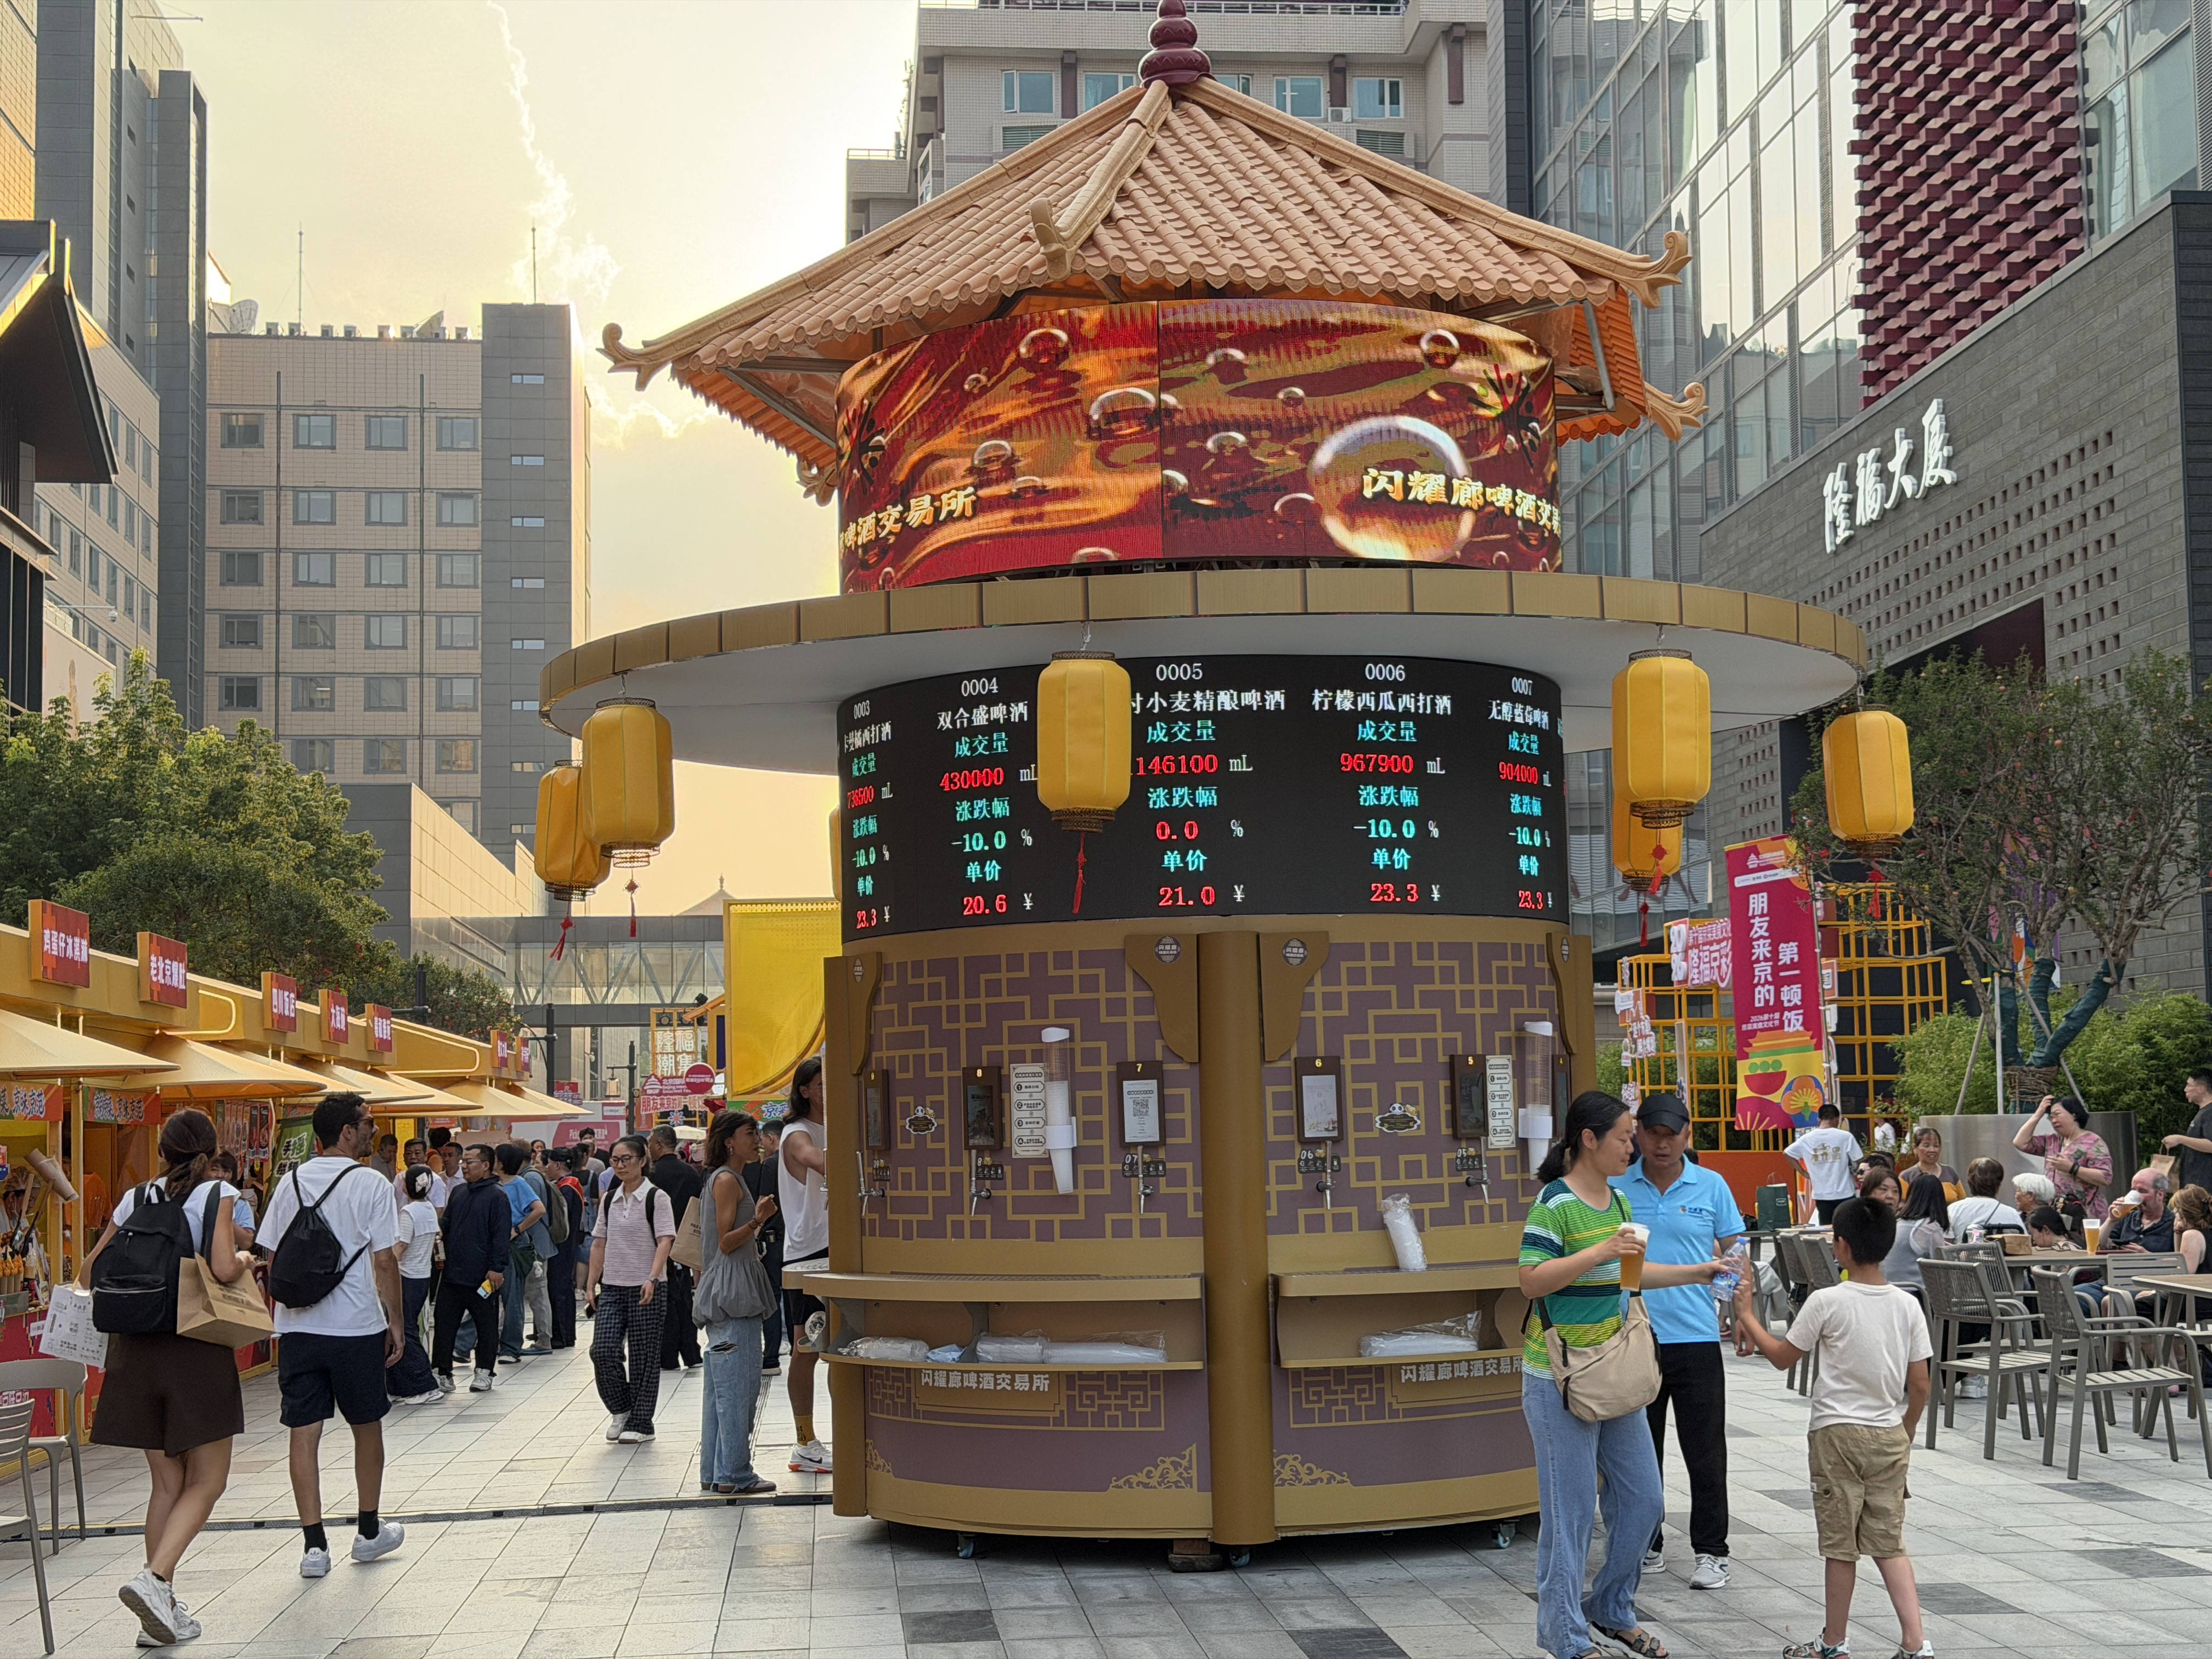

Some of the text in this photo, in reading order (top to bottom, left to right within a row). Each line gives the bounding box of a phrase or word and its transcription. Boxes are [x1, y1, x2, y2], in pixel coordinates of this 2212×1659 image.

[1156, 663, 1203, 681] 0005
[1365, 663, 1406, 681] 0006
[961, 677, 998, 696] 0004
[1511, 676, 1533, 696] 0007
[854, 700, 870, 719] 0003
[1312, 689, 1452, 714] 柠檬西瓜西打酒
[936, 701, 1029, 731] 双合盛啤酒
[1488, 699, 1549, 730] 无醇蓝莓啤酒
[1147, 720, 1216, 743] 成交量
[1357, 720, 1418, 743] 成交量
[1508, 730, 1540, 755] 成交量
[955, 731, 1009, 758] 成交量
[1229, 755, 1253, 772] mL
[1340, 753, 1445, 775] 967900 mL
[1499, 761, 1539, 785] 904000
[940, 767, 1005, 792] 430000
[1148, 786, 1217, 809] 涨跌幅
[1358, 785, 1419, 808] 涨跌幅
[1510, 793, 1542, 816] 涨跌幅
[955, 797, 1011, 822] 涨跌幅
[1156, 820, 1244, 841] 0.0 %
[1353, 819, 1438, 839] -10.0 %
[1509, 826, 1541, 847] -10.0
[951, 828, 1032, 854] -10.0 %
[1161, 849, 1207, 873] 单价
[1371, 848, 1411, 871] 单价
[1519, 854, 1539, 876] 单价
[966, 860, 1002, 883] 单价
[857, 876, 873, 897] 单价
[1159, 884, 1245, 907] 21.0 ¥
[1370, 883, 1441, 904] 23.3 ¥
[963, 892, 1034, 916] 20.6 ¥
[1518, 890, 1544, 911] 23.3
[1748, 891, 1774, 1007] 朋友来京的
[1778, 941, 1804, 1032] 第一顿饭
[977, 1069, 982, 1077] 8
[1136, 1063, 1142, 1072] 7
[1315, 1059, 1322, 1067] 6
[1125, 1154, 1138, 1163] 07
[1301, 1150, 1313, 1159] 06
[921, 1369, 1050, 1392] 闪耀廊啤酒交易所
